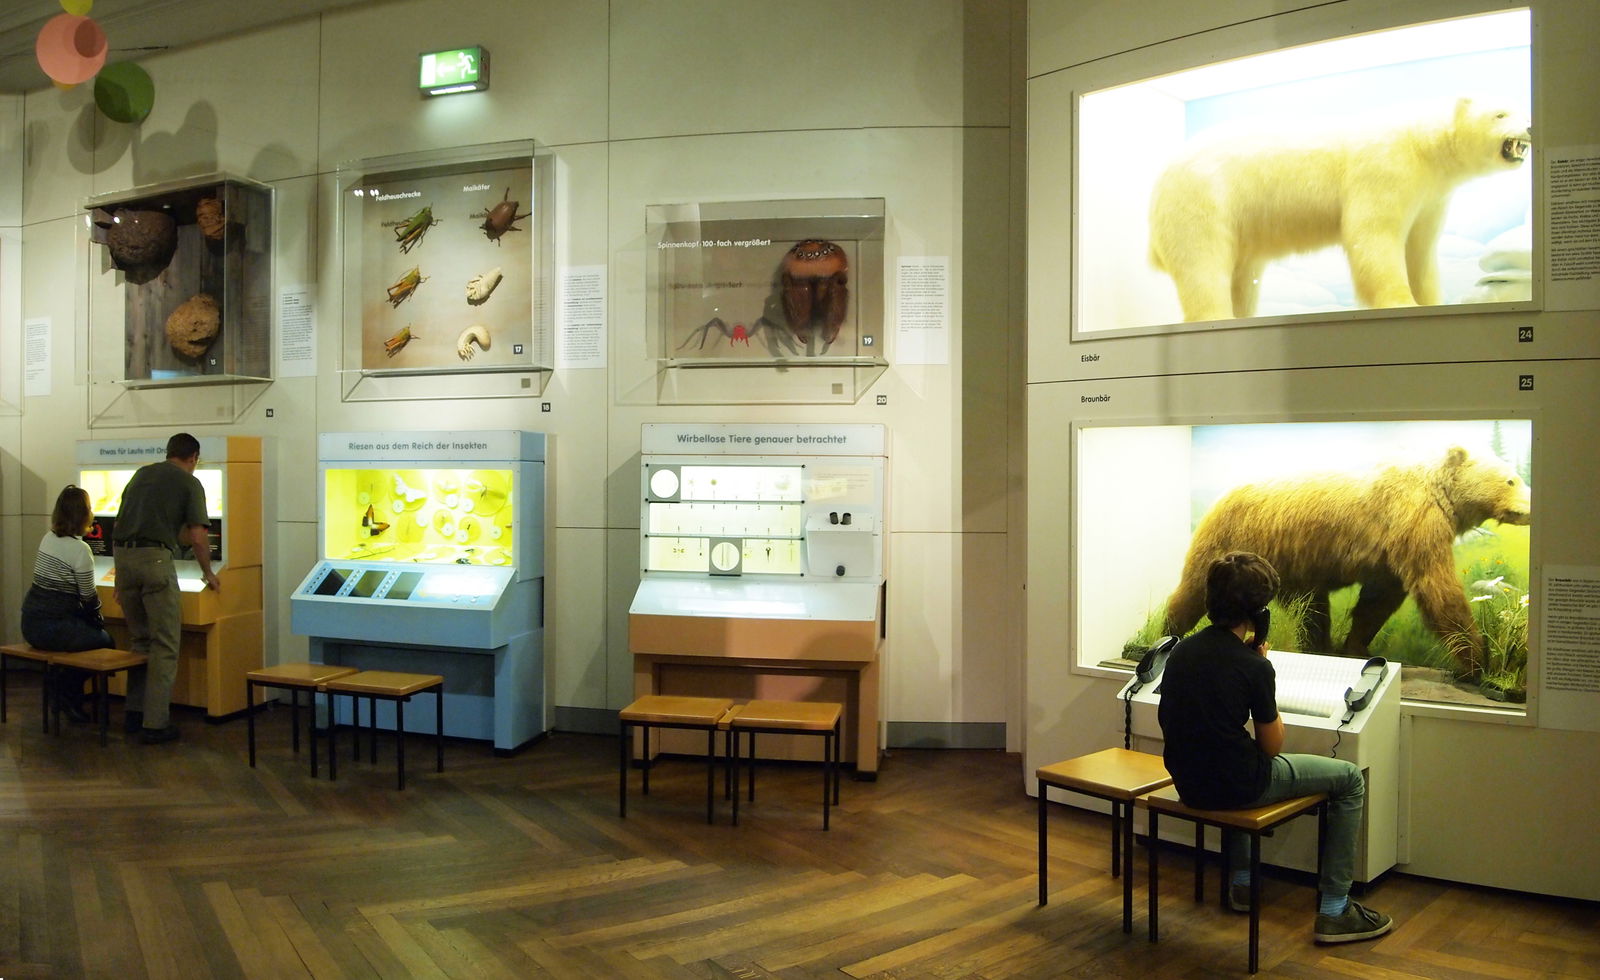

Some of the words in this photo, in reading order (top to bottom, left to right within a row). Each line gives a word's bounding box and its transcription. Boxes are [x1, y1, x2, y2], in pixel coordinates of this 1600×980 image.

[462, 183, 491, 193] Maikäfer
[375, 190, 422, 202] Feldheuschrecke
[657, 240, 699, 250] Spinnenkopf
[701, 239, 733, 248] 100-fach
[733, 238, 771, 248] vergrößert
[1520, 329, 1532, 340] 24
[863, 337, 873, 345] 19
[1081, 353, 1100, 362] Eisbär
[1520, 378, 1533, 388] 25
[1080, 394, 1111, 403] Braunbär
[677, 434, 726, 444] Wirbellose
[728, 434, 752, 444] Tiere
[754, 435, 793, 445] genauer
[796, 434, 847, 444] betrachtet
[118, 447, 126, 455] für
[349, 442, 374, 451] Riesen
[376, 442, 390, 450] aus
[392, 441, 410, 451] dem
[411, 441, 434, 450] Reich
[436, 441, 450, 450] der
[452, 441, 488, 450] Insekten
